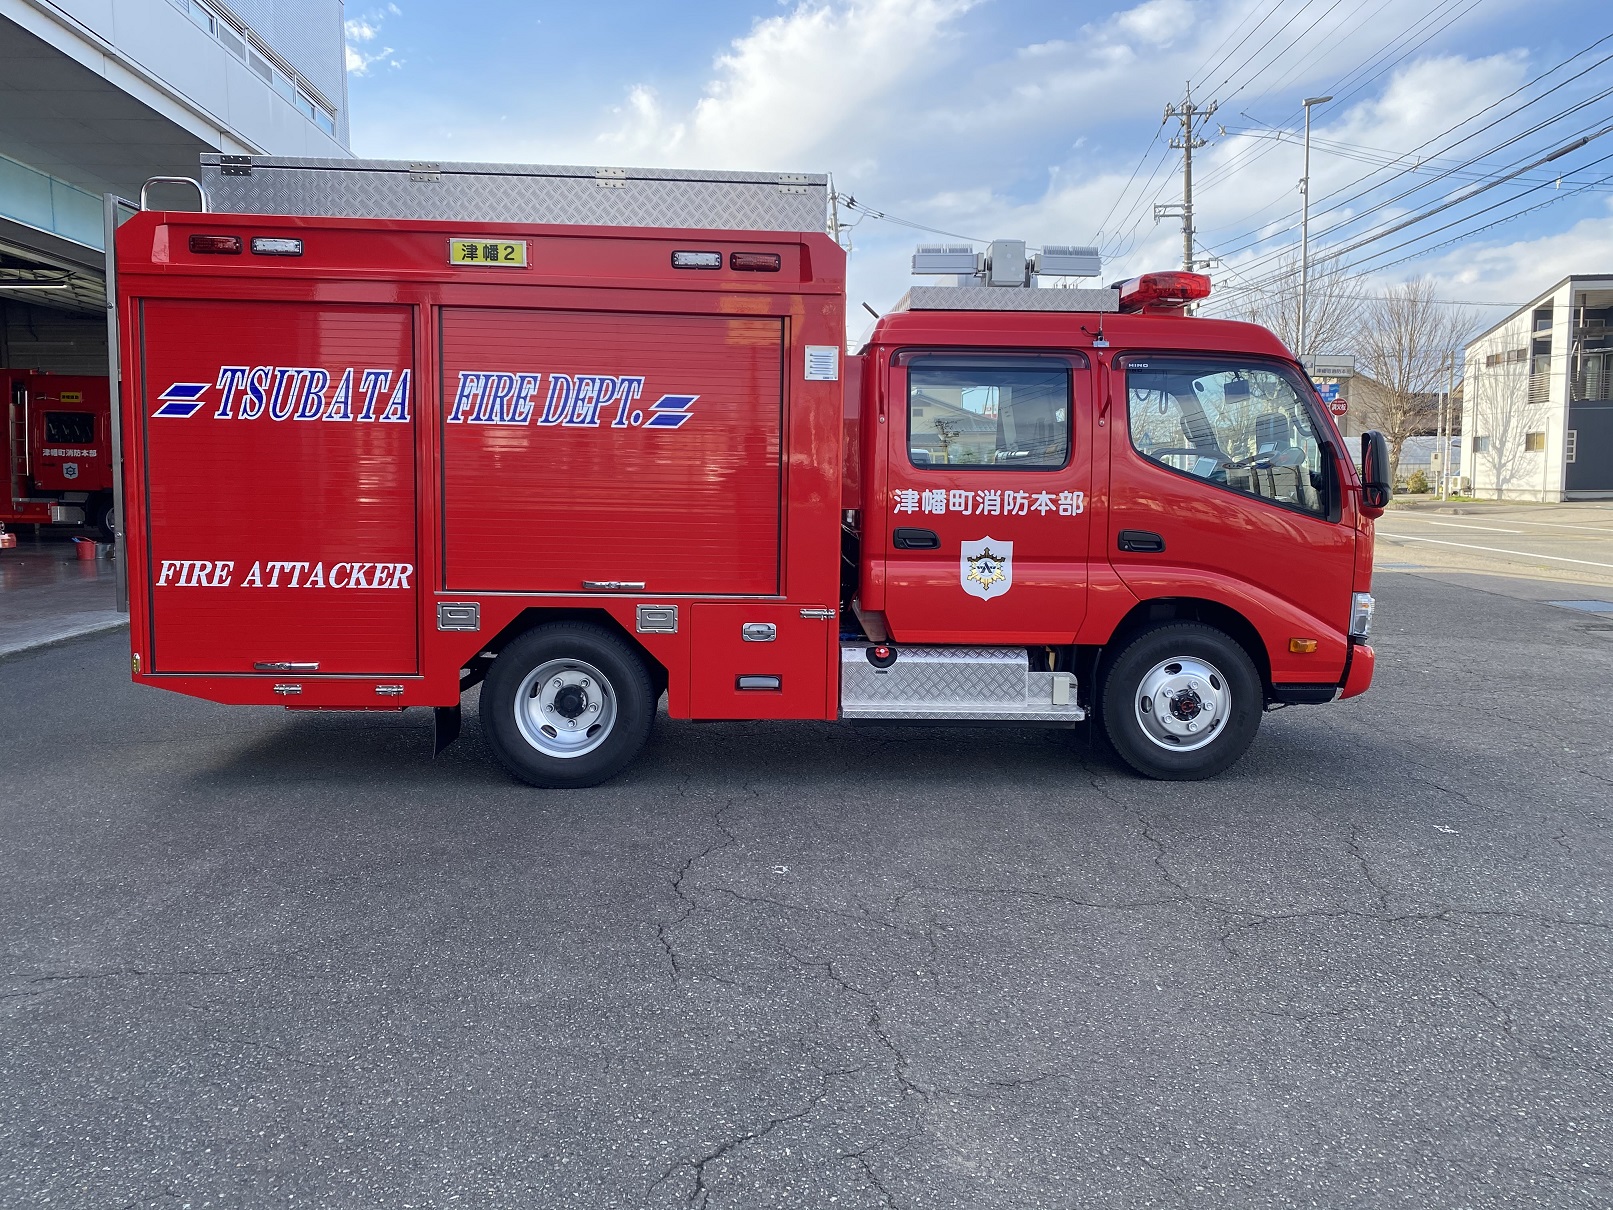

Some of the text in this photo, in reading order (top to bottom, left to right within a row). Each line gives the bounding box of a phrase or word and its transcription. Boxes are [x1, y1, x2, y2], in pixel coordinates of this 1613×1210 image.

[462, 244, 515, 261] 津幡2
[214, 366, 645, 428] TSUBATA FIRE DEPT.
[893, 489, 1085, 517] 津幡町消防本部
[155, 560, 414, 590] FIRE ATTACKER
